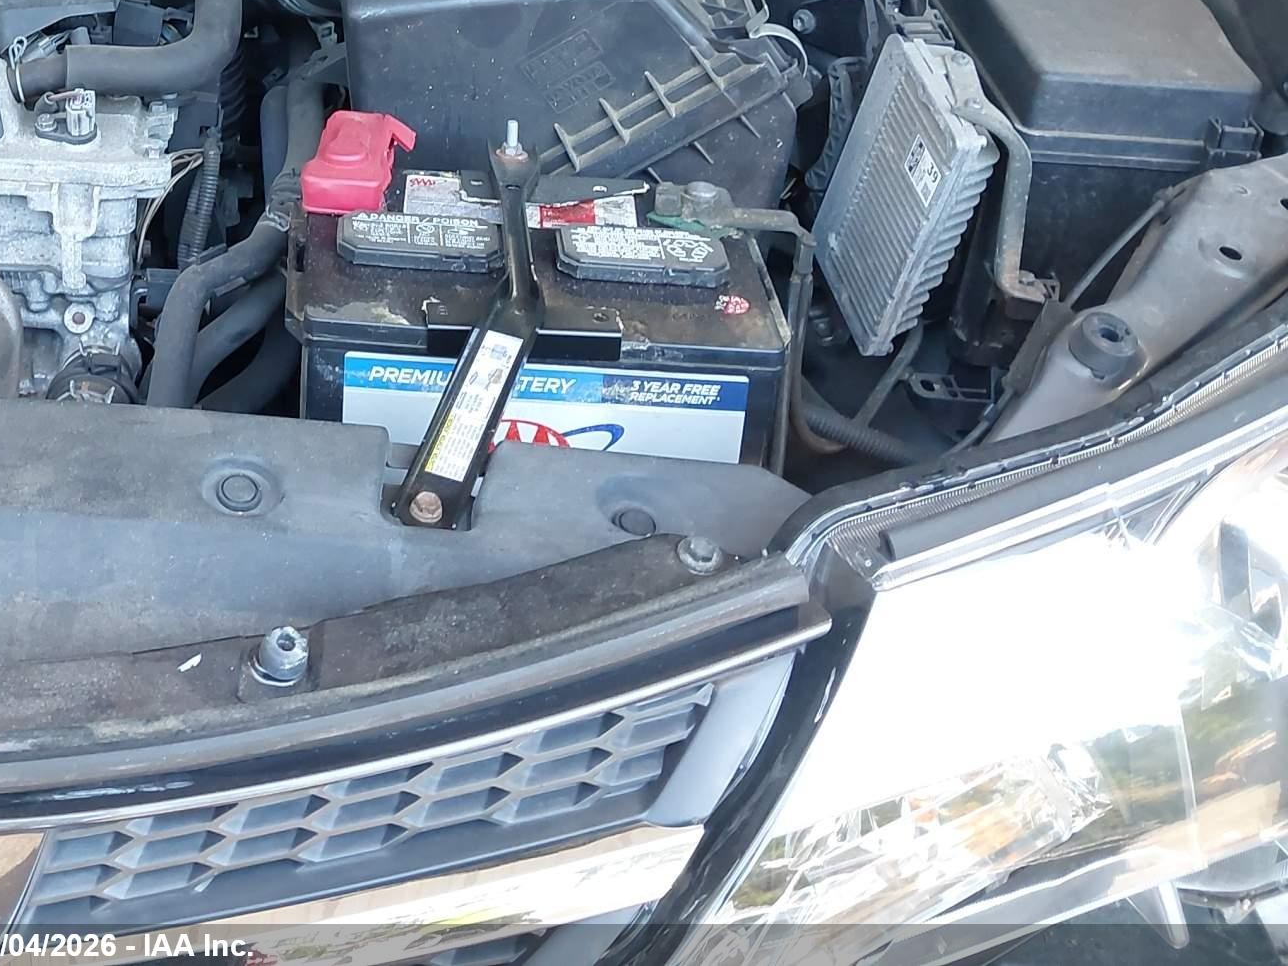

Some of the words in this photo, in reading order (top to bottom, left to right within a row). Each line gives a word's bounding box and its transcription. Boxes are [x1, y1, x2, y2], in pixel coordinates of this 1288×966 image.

[369, 213, 419, 224] DANGER
[432, 218, 479, 226] POISON
[368, 366, 452, 385] PREMIU
[516, 375, 577, 394] TERY
[631, 380, 641, 391] 3
[643, 381, 681, 394] YEAR
[682, 384, 721, 396] FREE
